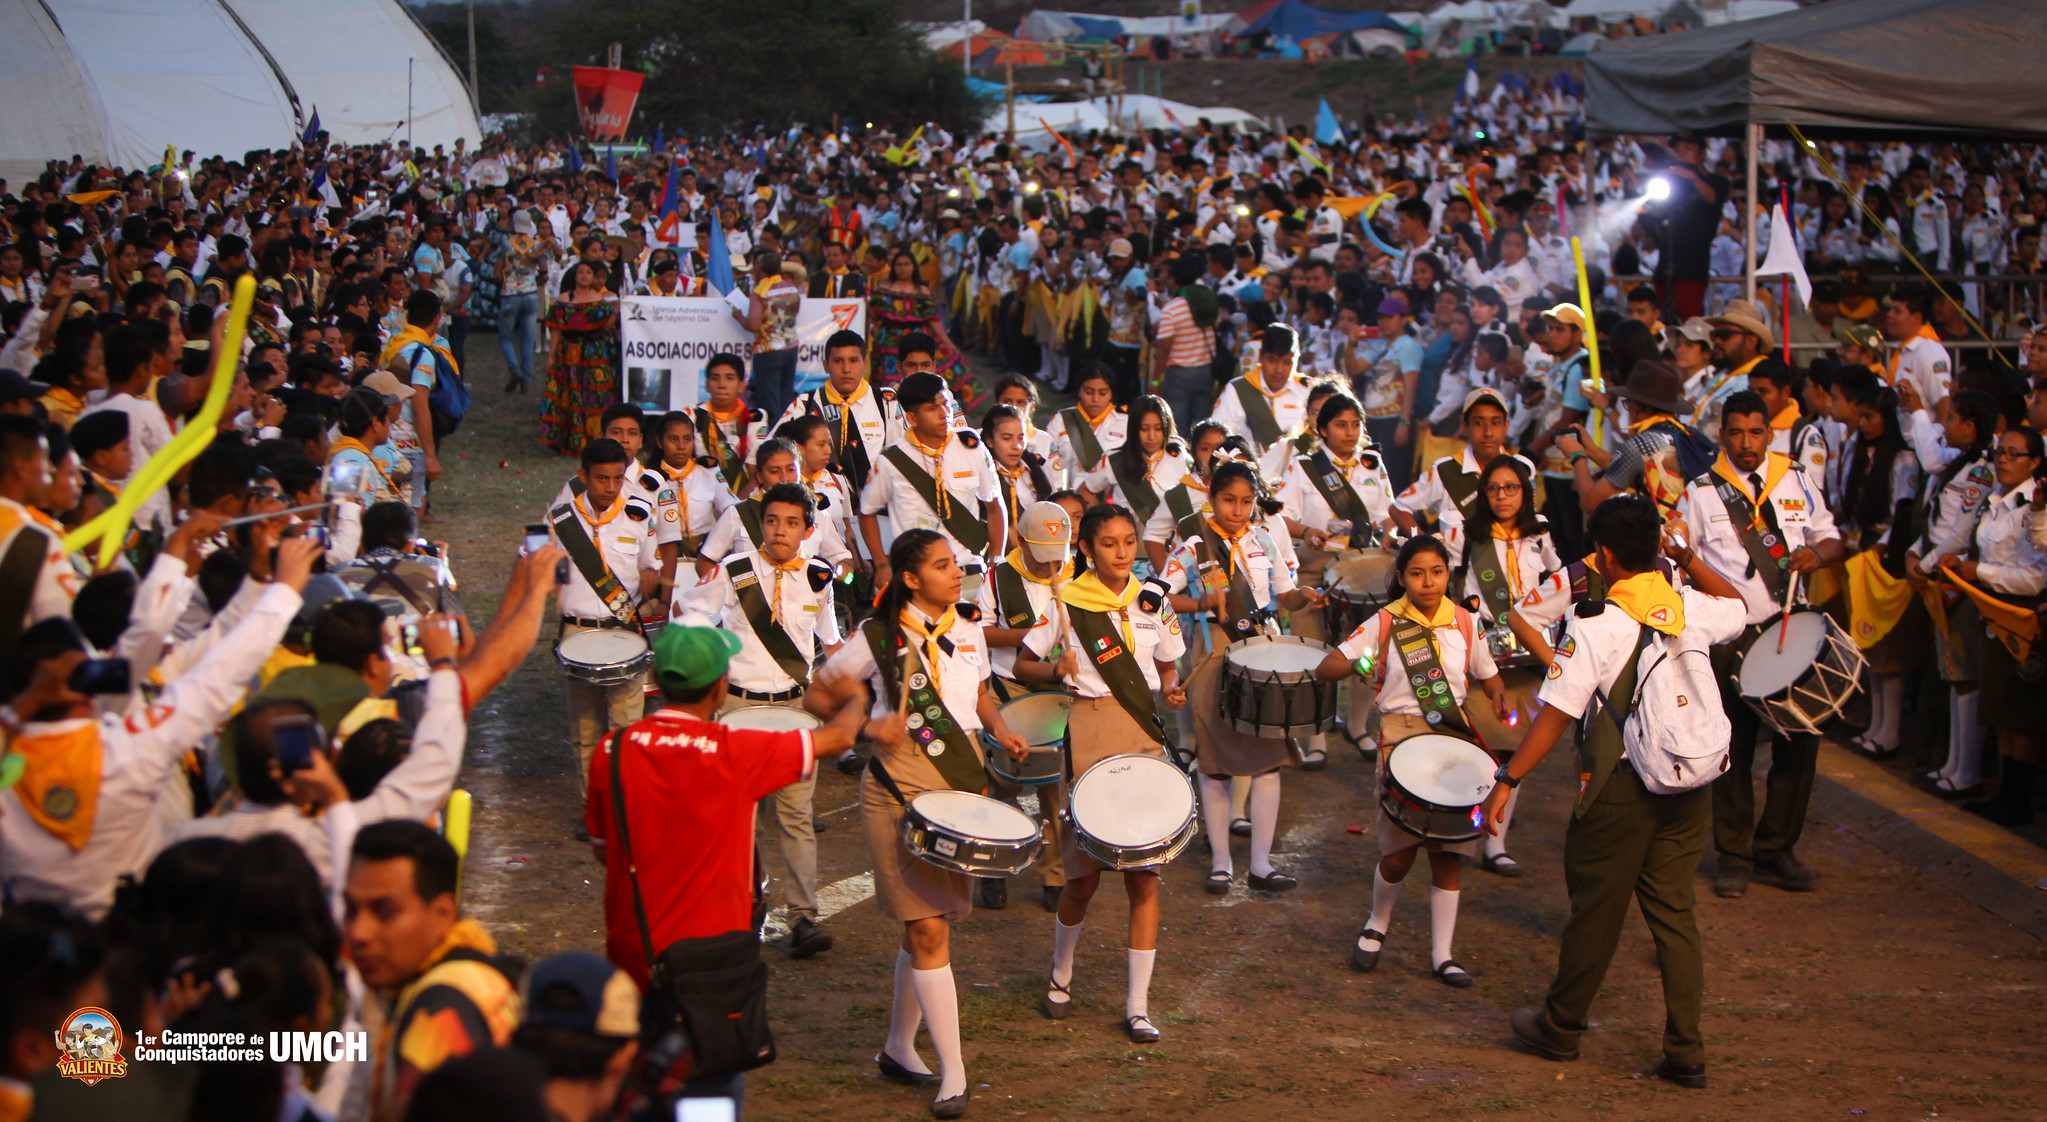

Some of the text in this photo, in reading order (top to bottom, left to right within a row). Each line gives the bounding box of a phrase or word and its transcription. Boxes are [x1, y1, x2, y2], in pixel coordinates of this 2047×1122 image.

[652, 306, 719, 315] Iglesia Adventista
[625, 340, 718, 359] ASOCIACION
[722, 341, 753, 360] OES
